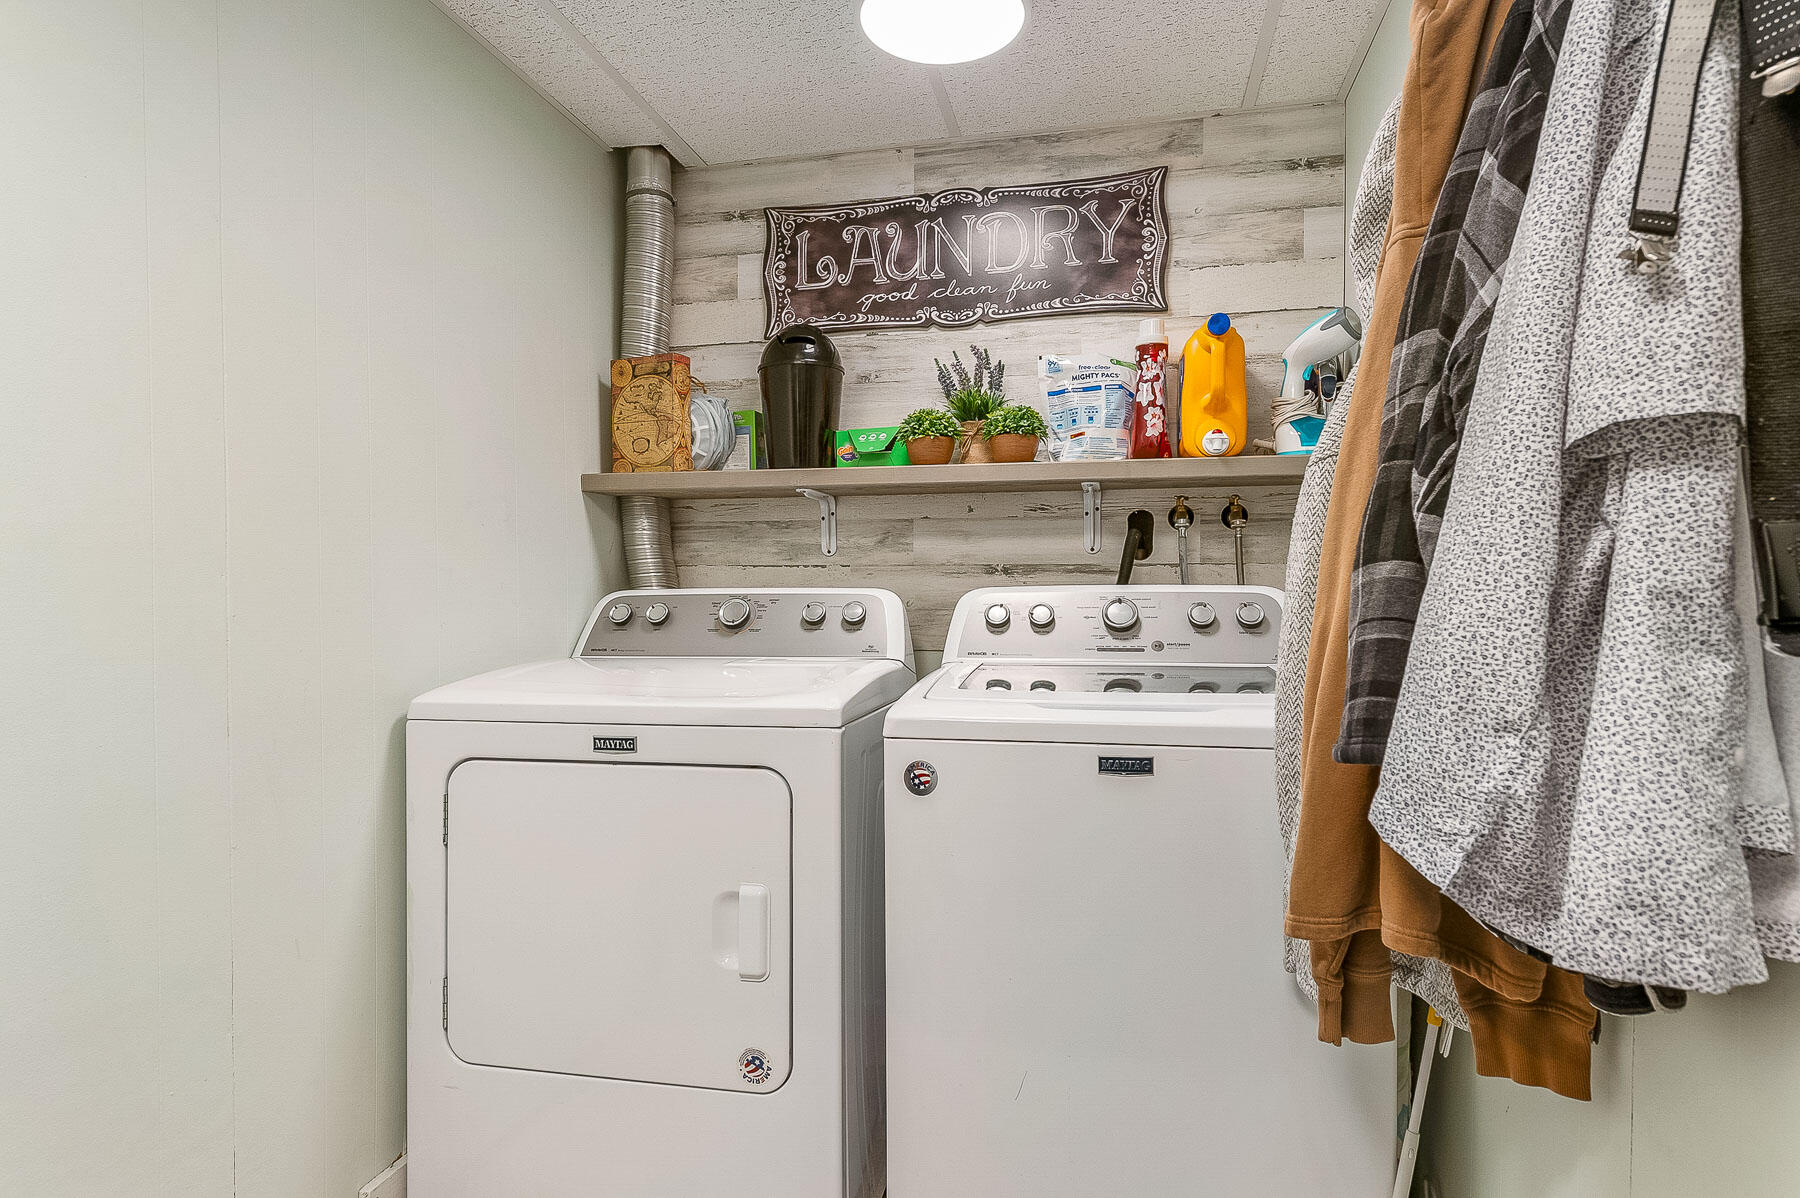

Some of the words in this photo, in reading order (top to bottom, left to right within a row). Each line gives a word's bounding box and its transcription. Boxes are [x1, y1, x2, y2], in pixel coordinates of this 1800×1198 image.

[794, 198, 1136, 291] LAUNDRY
[857, 282, 919, 313] good
[927, 278, 999, 299] clean
[1006, 273, 1053, 304] fun
[1071, 372, 1100, 382] MIGHTY
[594, 739, 634, 749] MAYTAG
[1100, 759, 1151, 771] MAYTAG
[742, 1065, 773, 1085] AMERICA
